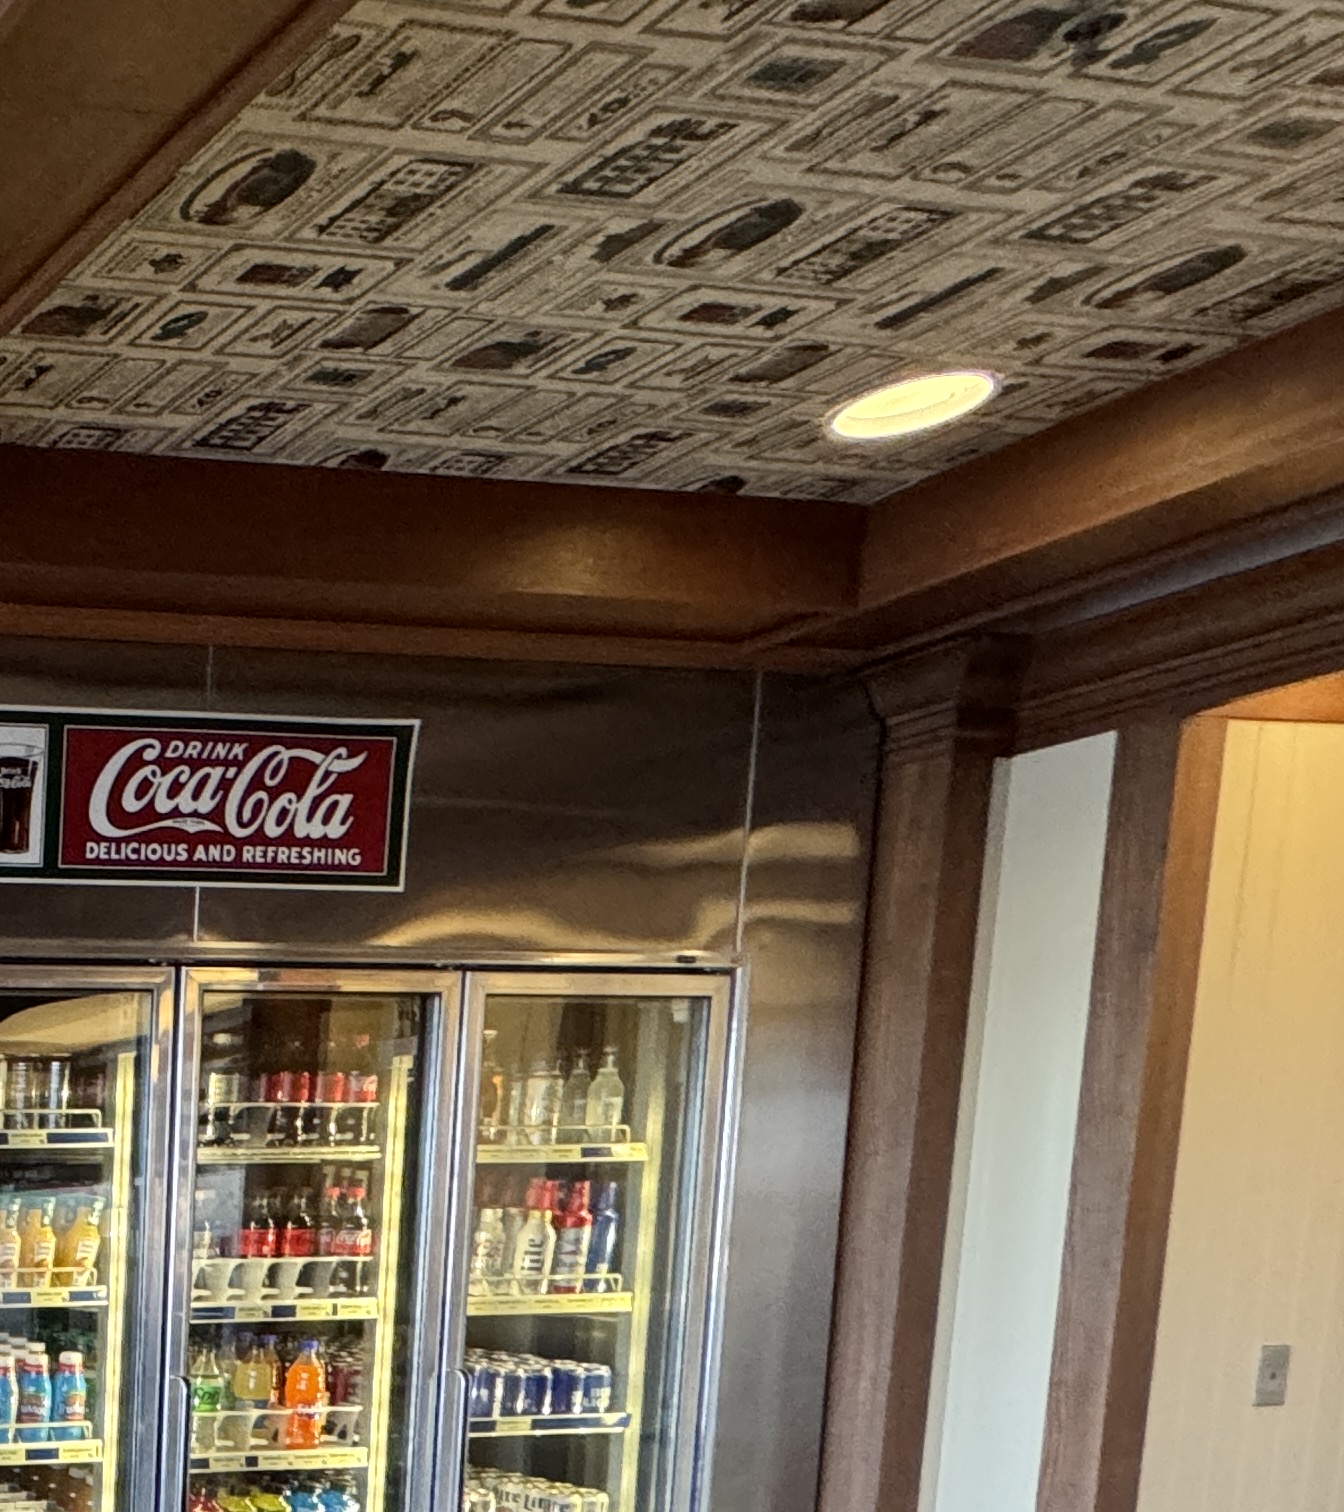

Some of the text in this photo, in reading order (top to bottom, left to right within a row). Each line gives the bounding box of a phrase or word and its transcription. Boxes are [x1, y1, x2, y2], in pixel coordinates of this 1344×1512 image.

[164, 739, 250, 761] DRINK
[88, 737, 368, 840] Coca-Cola
[85, 840, 362, 867] DELICIOUS AND REFRESHING
